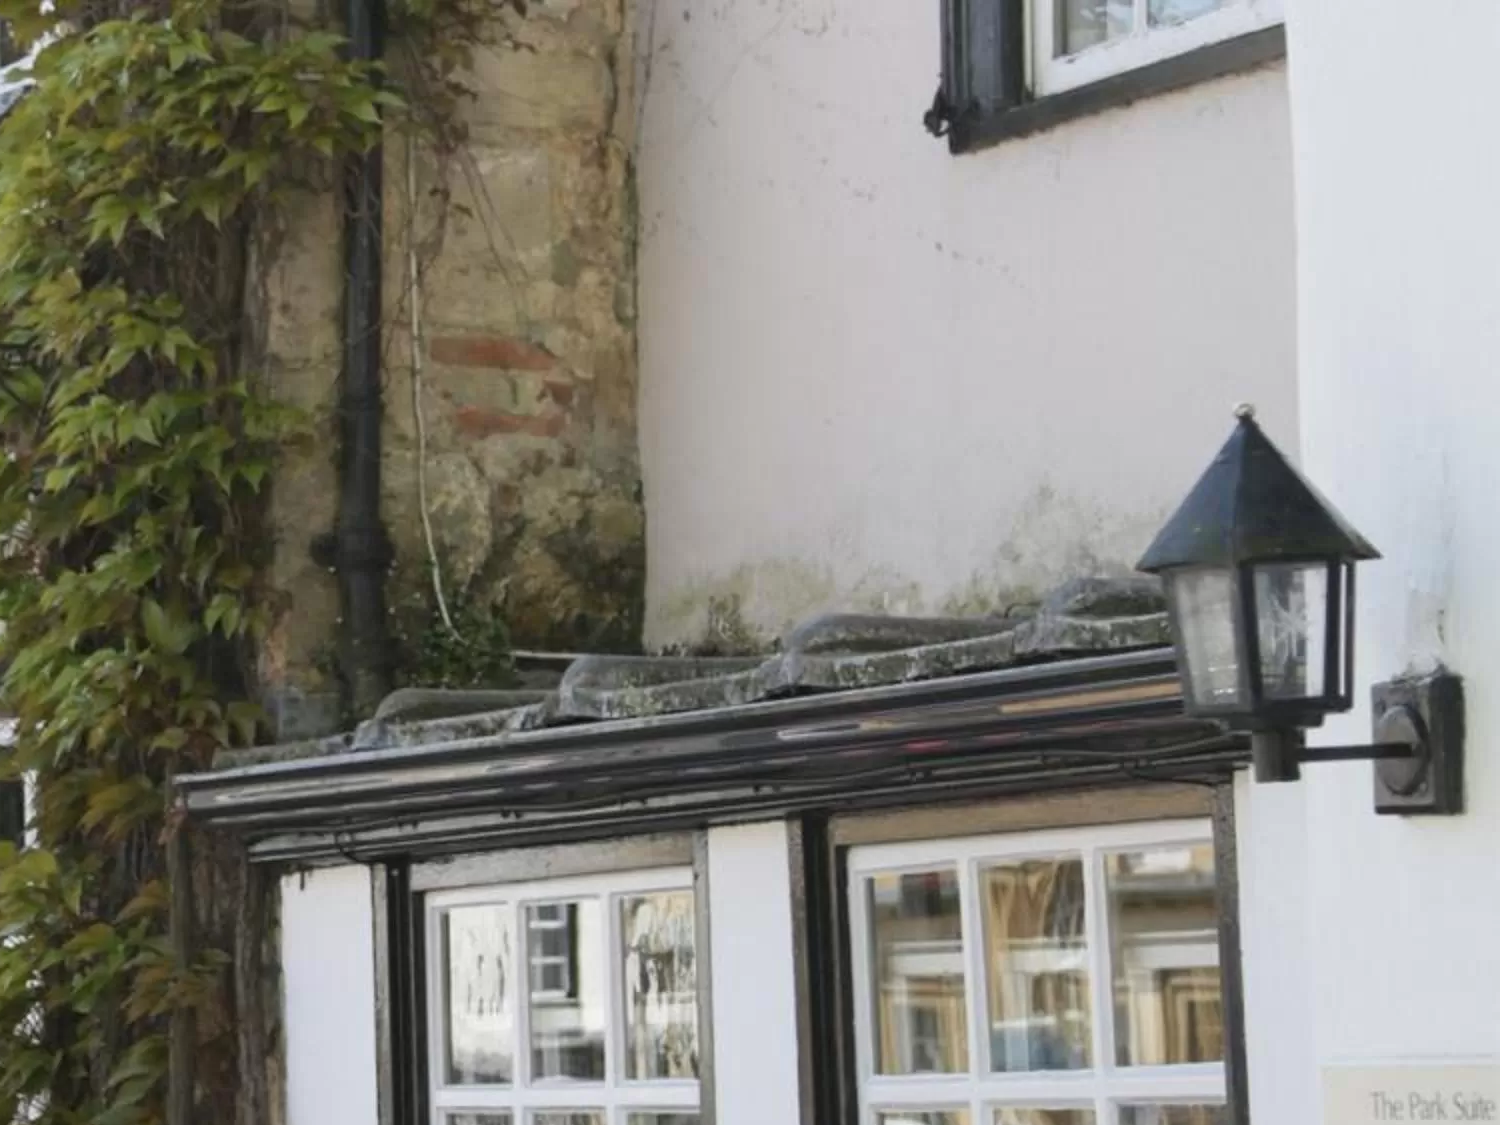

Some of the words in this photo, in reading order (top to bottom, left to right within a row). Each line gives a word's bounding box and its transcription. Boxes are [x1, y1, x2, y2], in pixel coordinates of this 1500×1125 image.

[1369, 1090, 1404, 1121] The
[1407, 1089, 1449, 1121] Park
[1452, 1090, 1497, 1121] Suite
